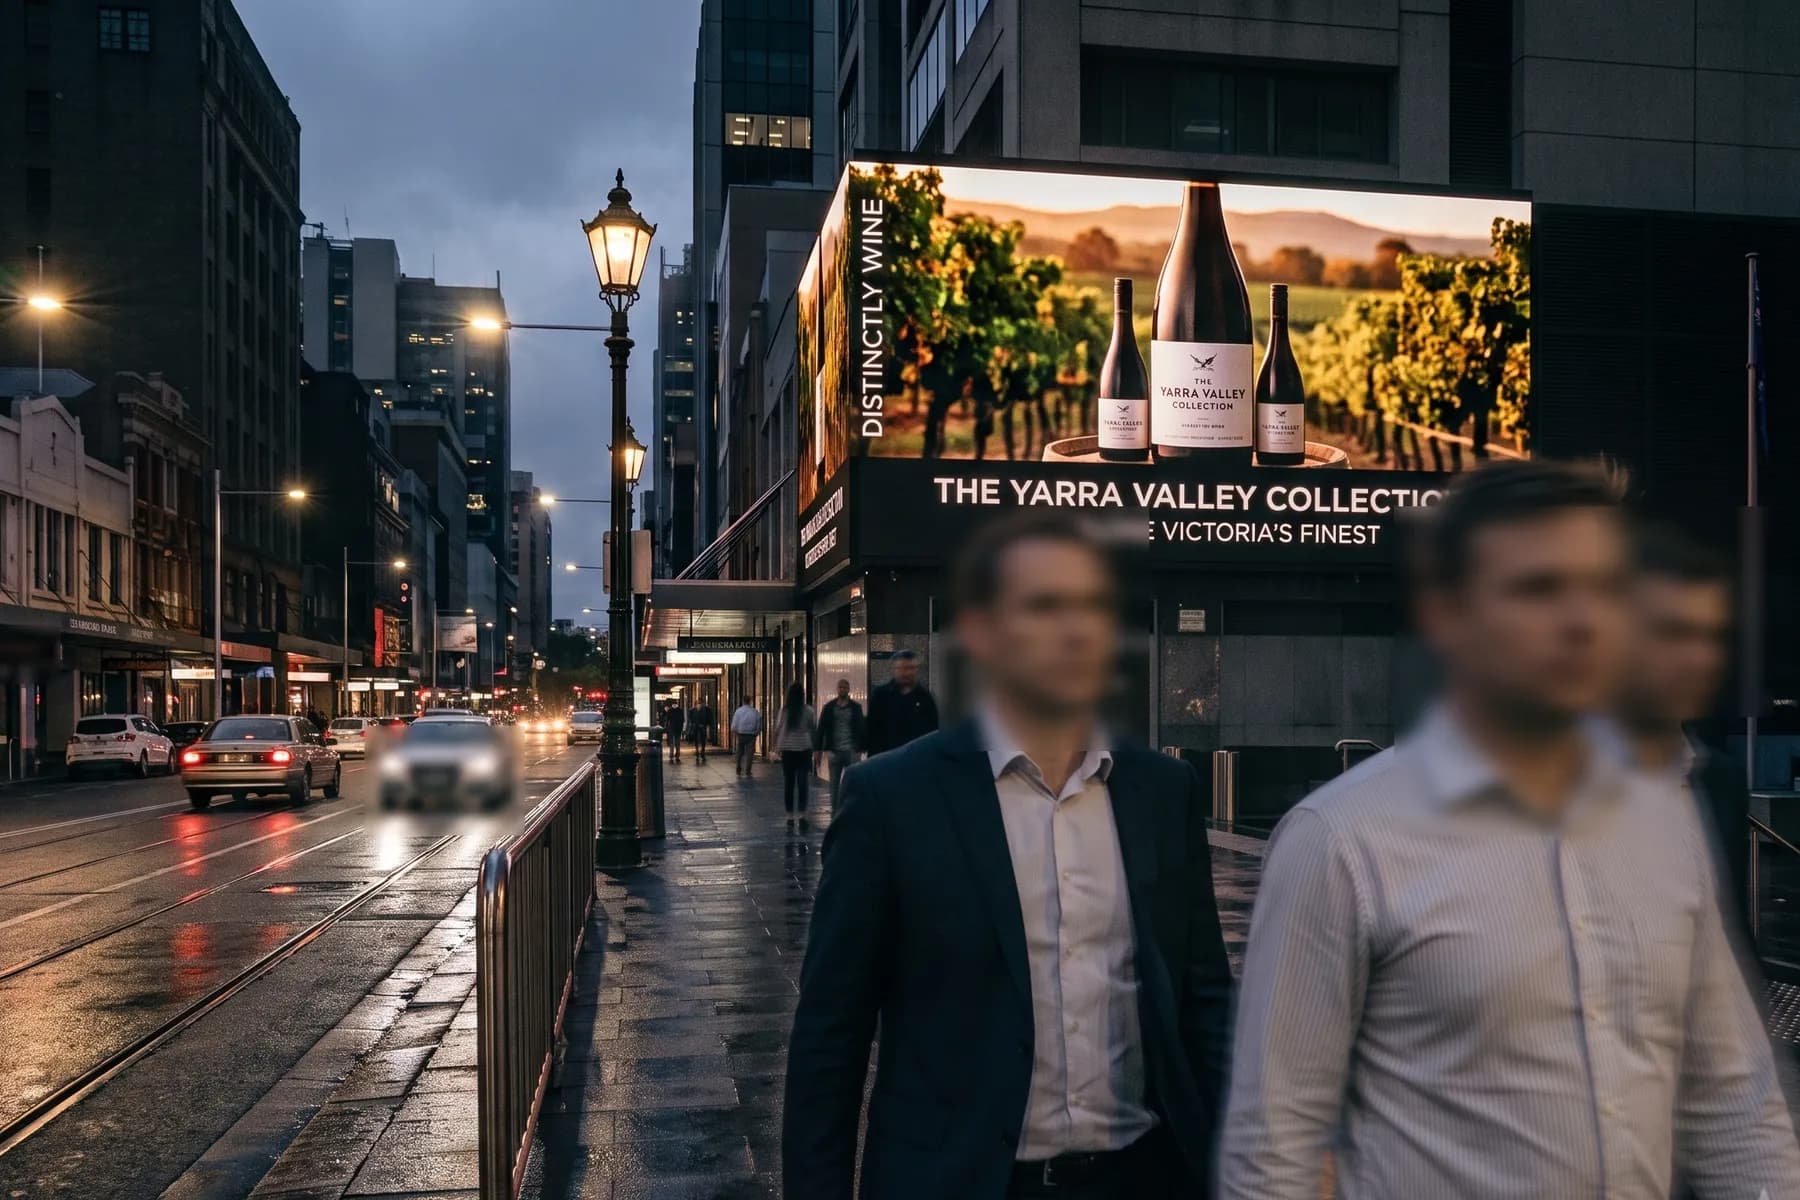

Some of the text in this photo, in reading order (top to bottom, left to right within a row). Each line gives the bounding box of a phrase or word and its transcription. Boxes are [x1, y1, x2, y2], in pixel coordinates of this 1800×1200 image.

[862, 199, 883, 437] DISTINCTLY WINE
[1160, 386, 1246, 399] YARRA VALLEY
[1172, 401, 1233, 410] COLLECTION
[933, 477, 1450, 513] THE YARRA VALLEY COLLECTIO
[1162, 521, 1293, 543] VICTORIA'S
[1300, 523, 1381, 545] FINEST
